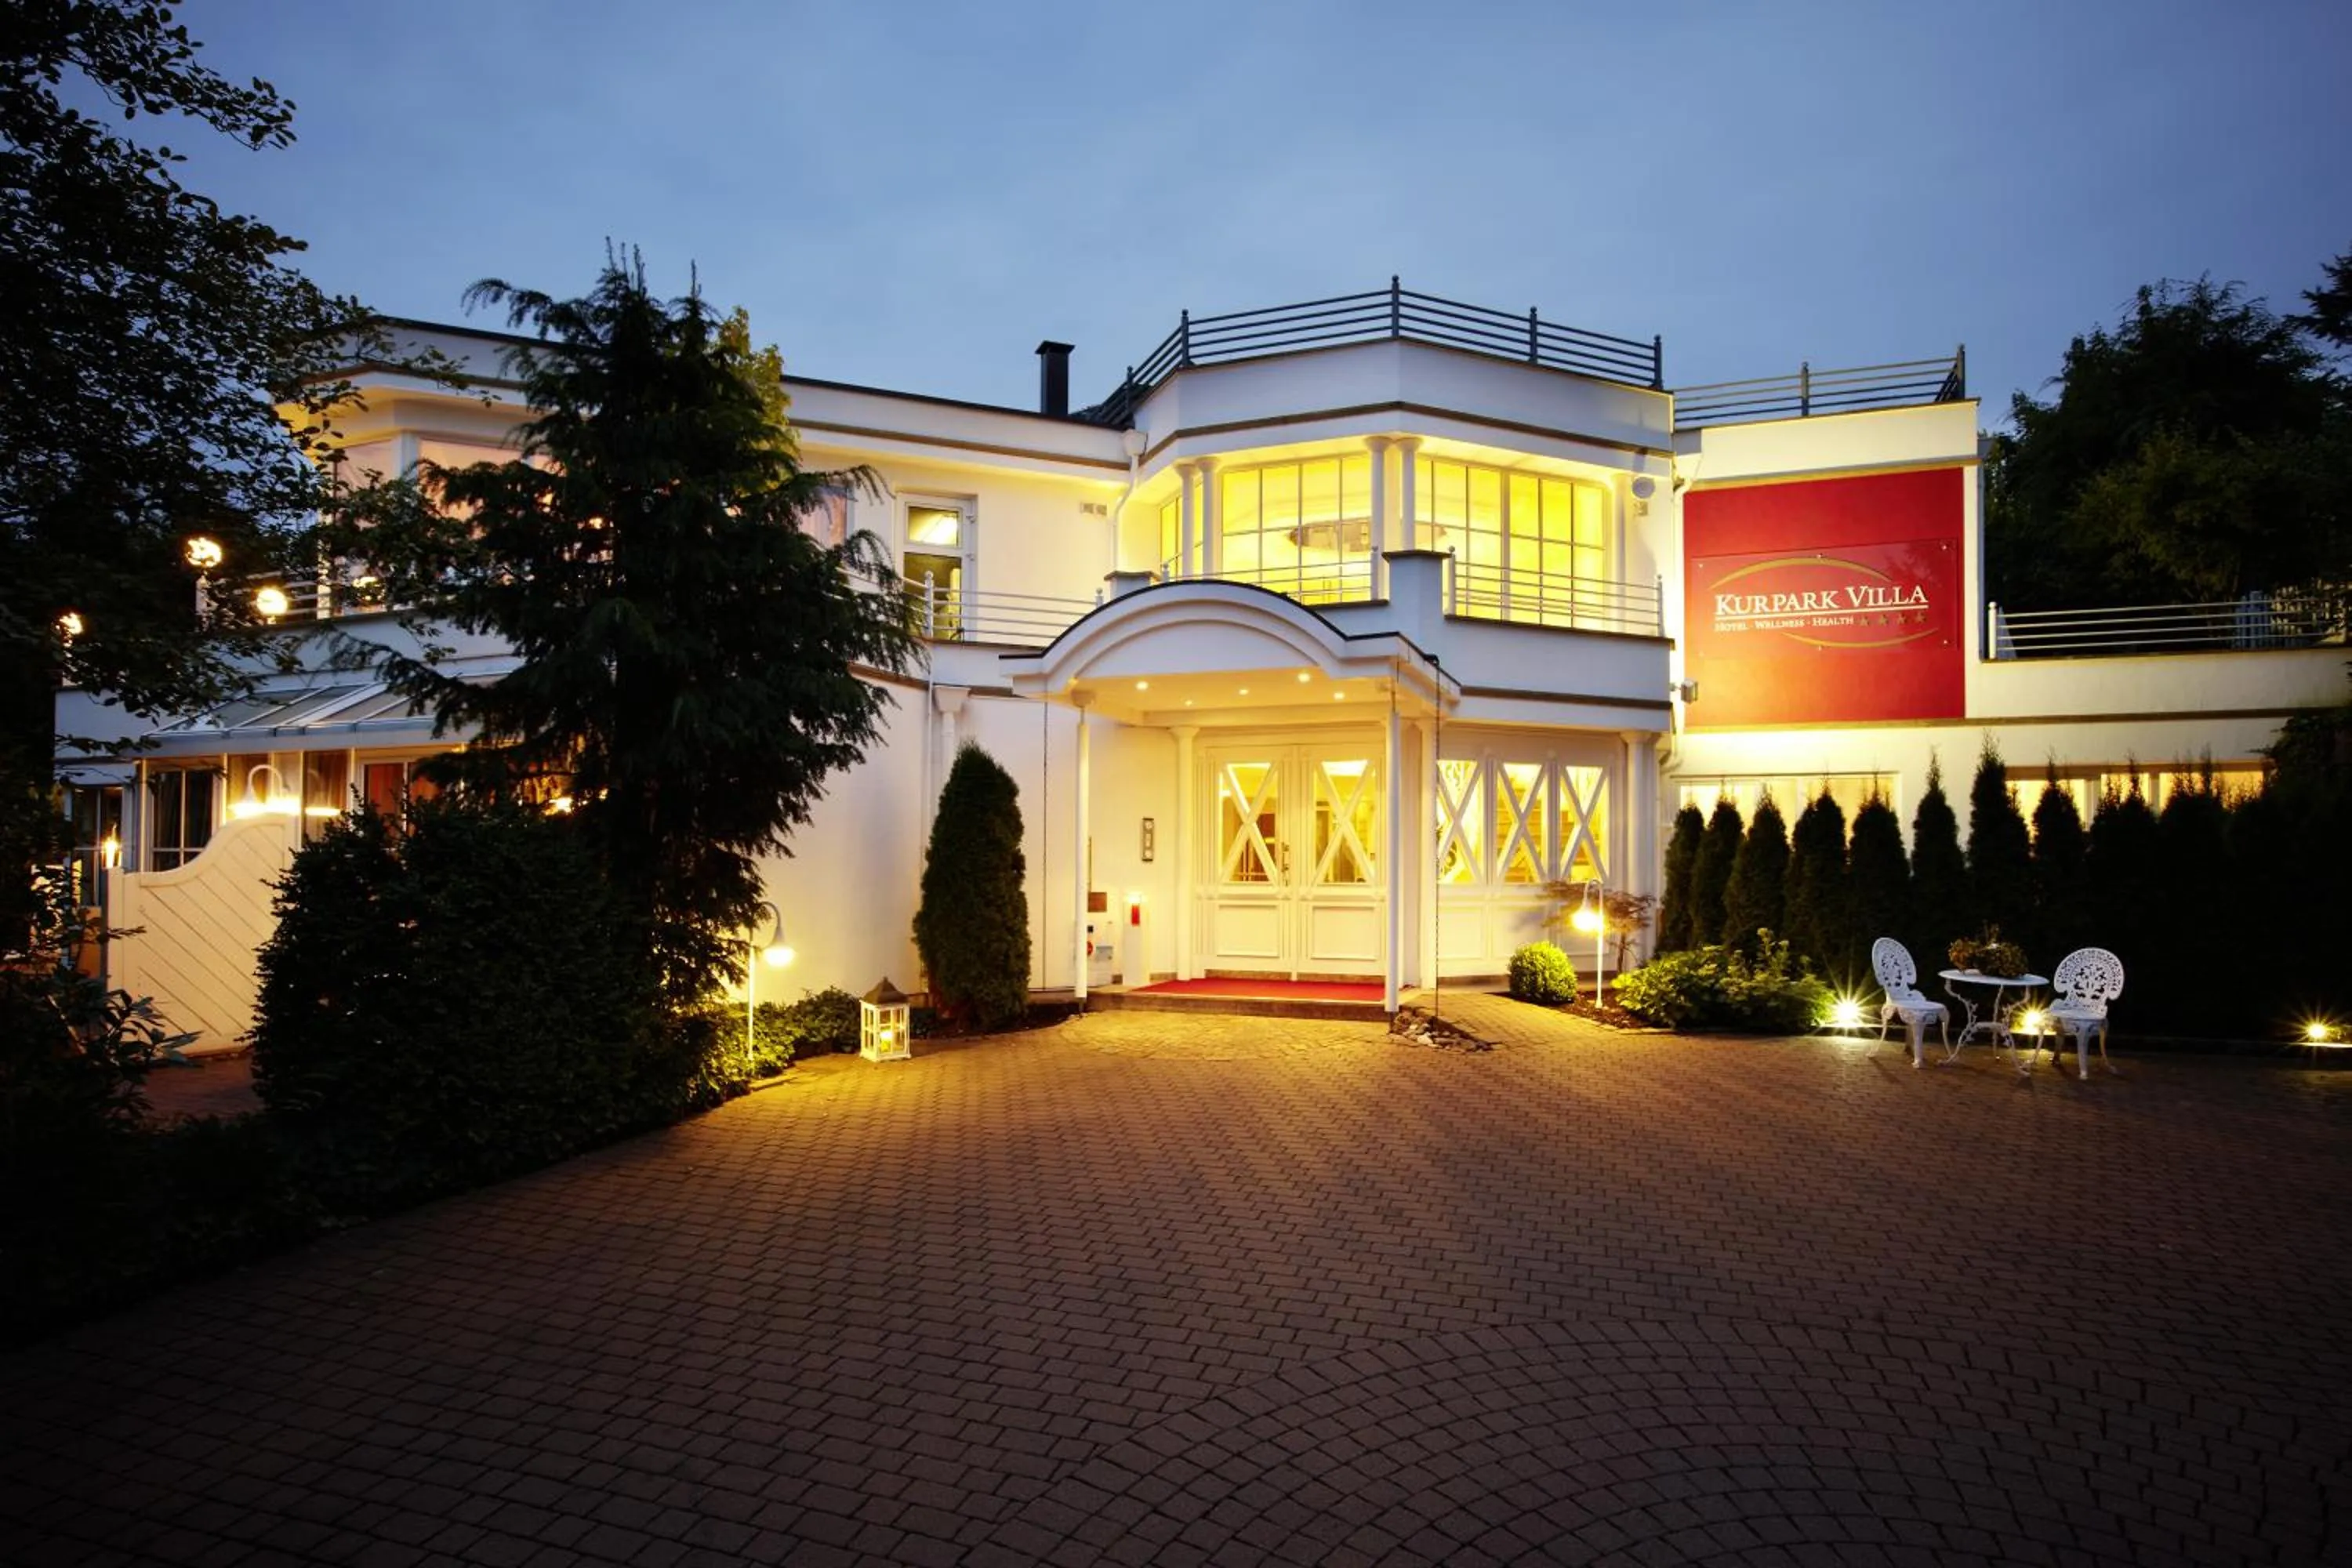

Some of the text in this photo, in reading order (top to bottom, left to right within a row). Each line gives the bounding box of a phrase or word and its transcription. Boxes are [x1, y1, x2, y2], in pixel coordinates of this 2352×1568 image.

[1714, 585, 1929, 615] KURPARK VILLA
[1755, 619, 1805, 630] WELLNESS
[1813, 616, 1854, 626] HEALTH
